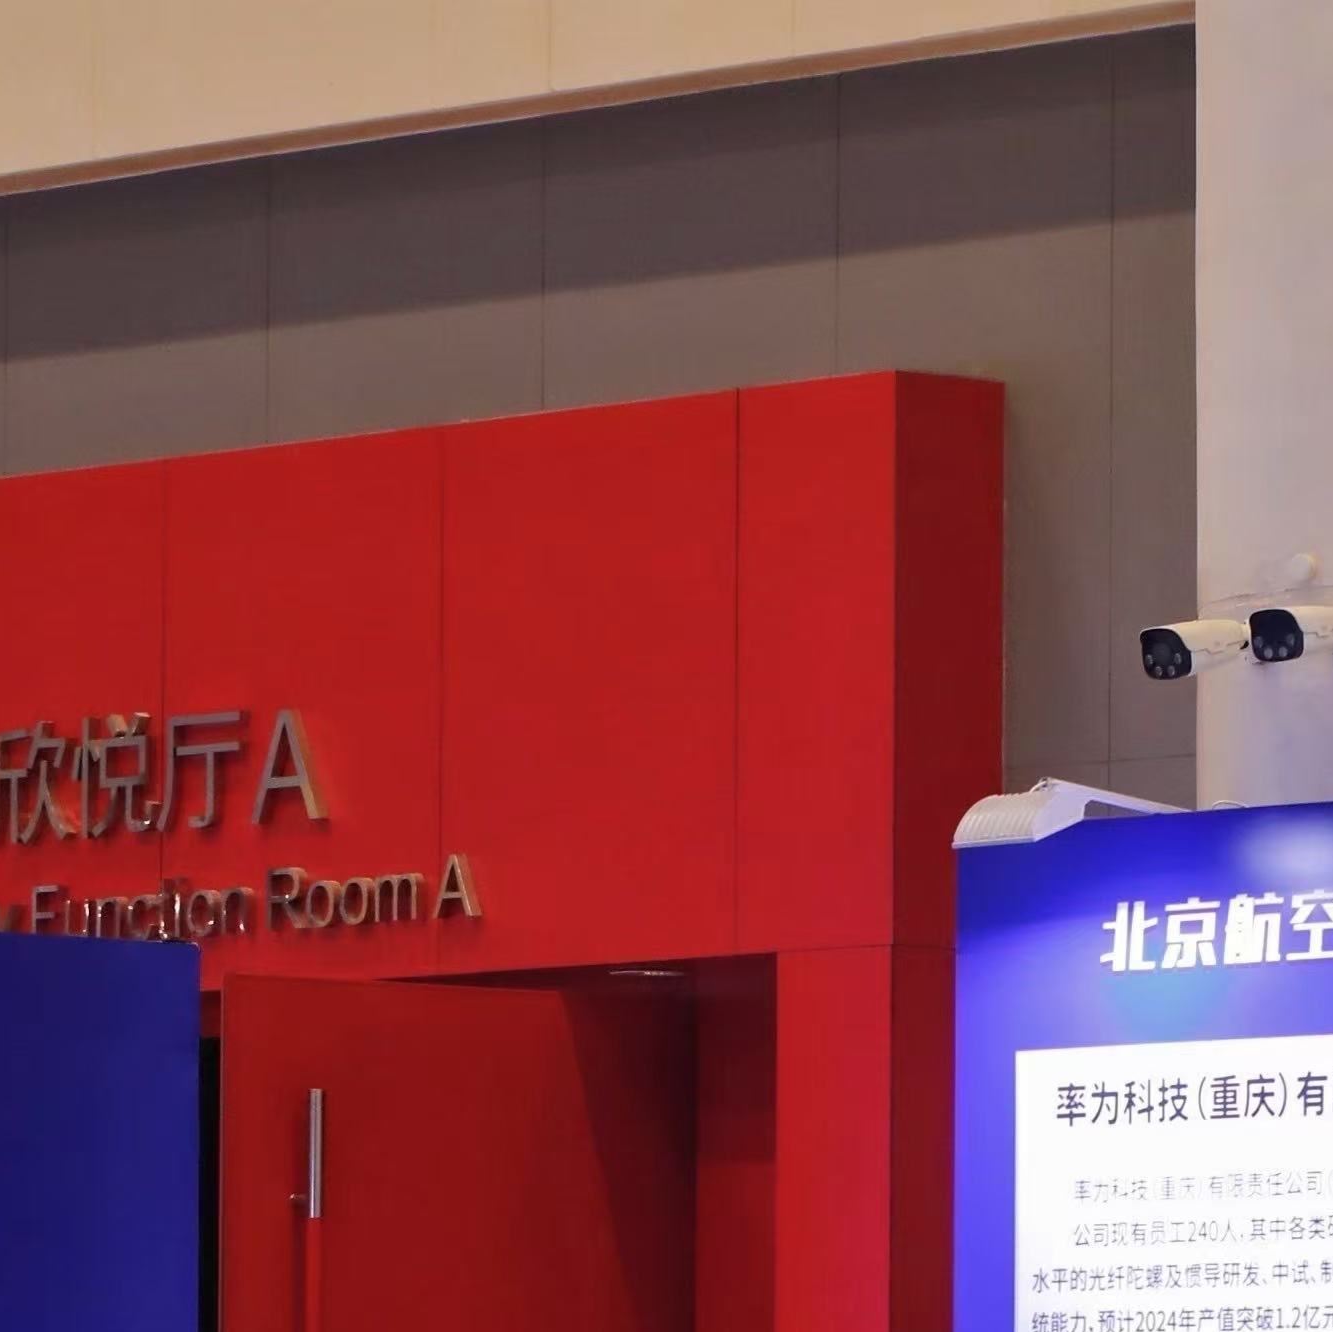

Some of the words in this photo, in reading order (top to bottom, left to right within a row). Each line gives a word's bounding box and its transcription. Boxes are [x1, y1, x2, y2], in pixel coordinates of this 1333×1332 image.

[31, 878, 255, 940] Function
[268, 866, 424, 931] Room
[434, 853, 484, 918] A
